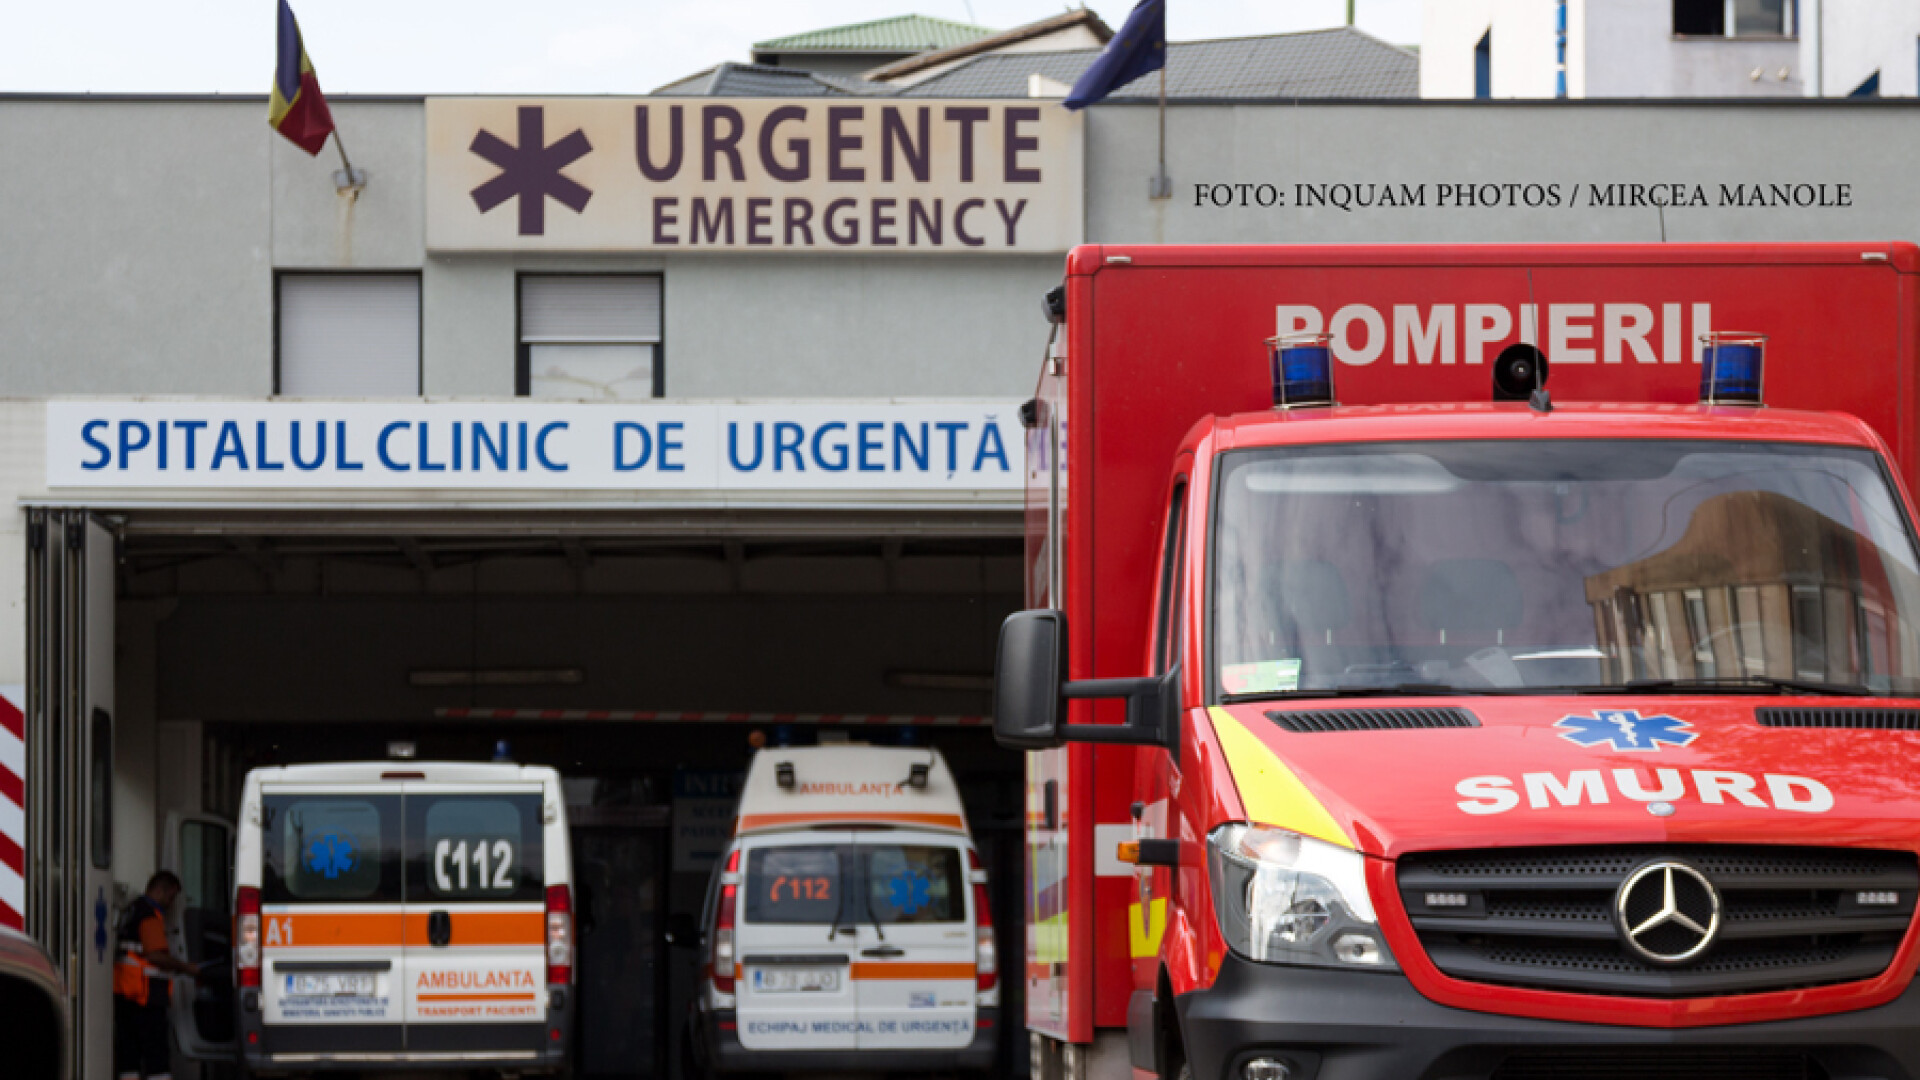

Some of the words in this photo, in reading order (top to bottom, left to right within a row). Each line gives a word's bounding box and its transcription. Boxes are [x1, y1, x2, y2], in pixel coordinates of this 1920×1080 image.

[634, 104, 1042, 183] URGENTE
[651, 196, 1029, 247] EMERGENCY
[1275, 302, 1711, 366] POMPIERII
[80, 419, 364, 472] SPITALUL
[376, 420, 570, 472] CLINIC
[613, 421, 685, 472] DE
[727, 414, 1011, 480] URGENȚĂ
[1455, 767, 1835, 816] SMURD
[451, 839, 514, 889] 112
[788, 876, 831, 900] 112
[266, 917, 293, 945] A1
[417, 1005, 482, 1017] TRANSPORT
[748, 1020, 807, 1036] ECHIPAJ
[812, 1020, 875, 1035] MEDICAL
[878, 1020, 898, 1034] DE
